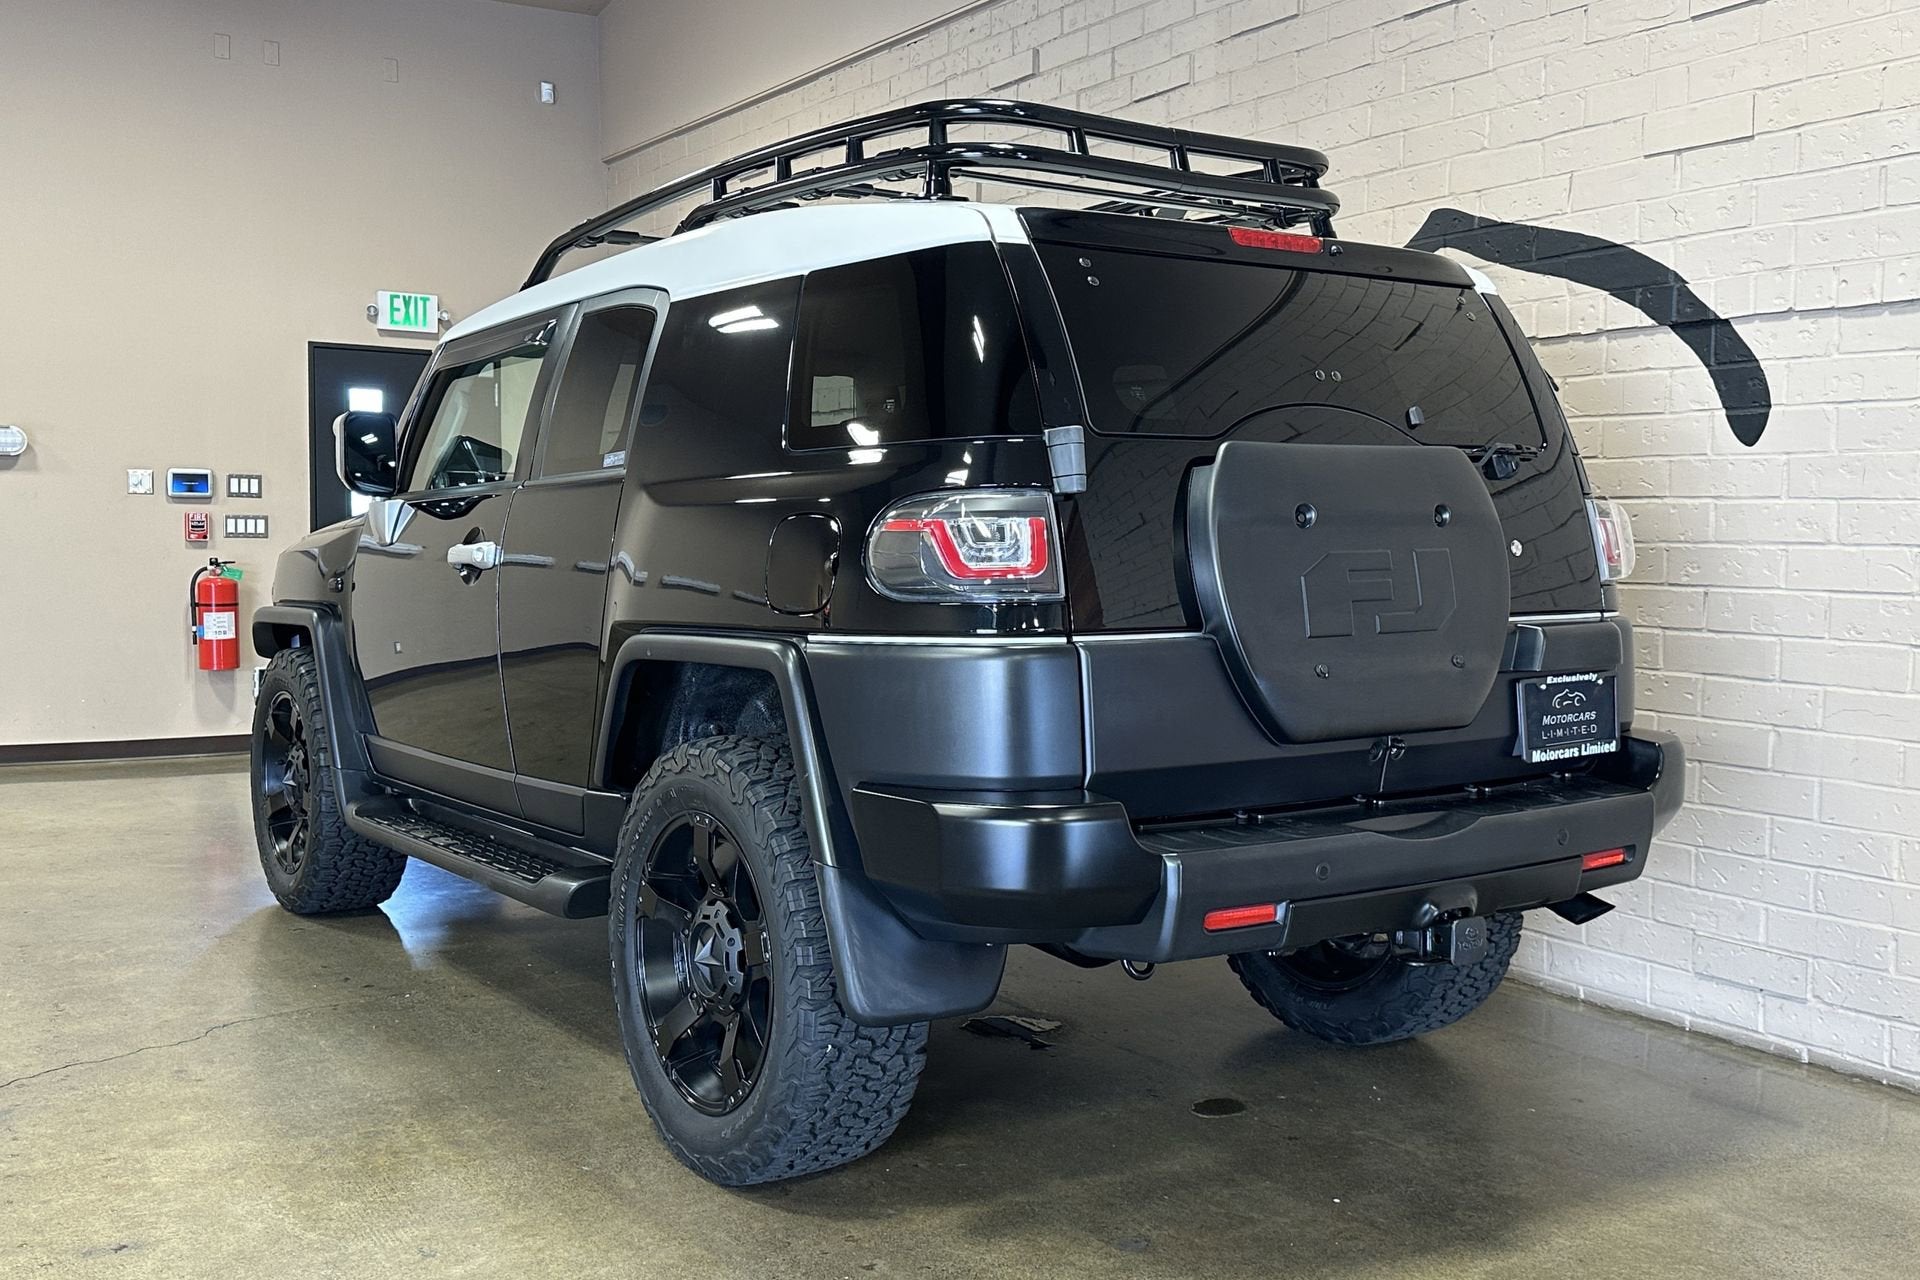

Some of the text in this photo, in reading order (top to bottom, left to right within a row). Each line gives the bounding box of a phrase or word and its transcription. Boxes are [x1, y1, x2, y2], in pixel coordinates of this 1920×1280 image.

[389, 294, 430, 328] EXIT
[1301, 548, 1457, 639] FJ
[1546, 672, 1598, 684] Exclusively
[1542, 711, 1597, 726] MOTORCARS
[1532, 740, 1617, 763] Motorcars Limited
